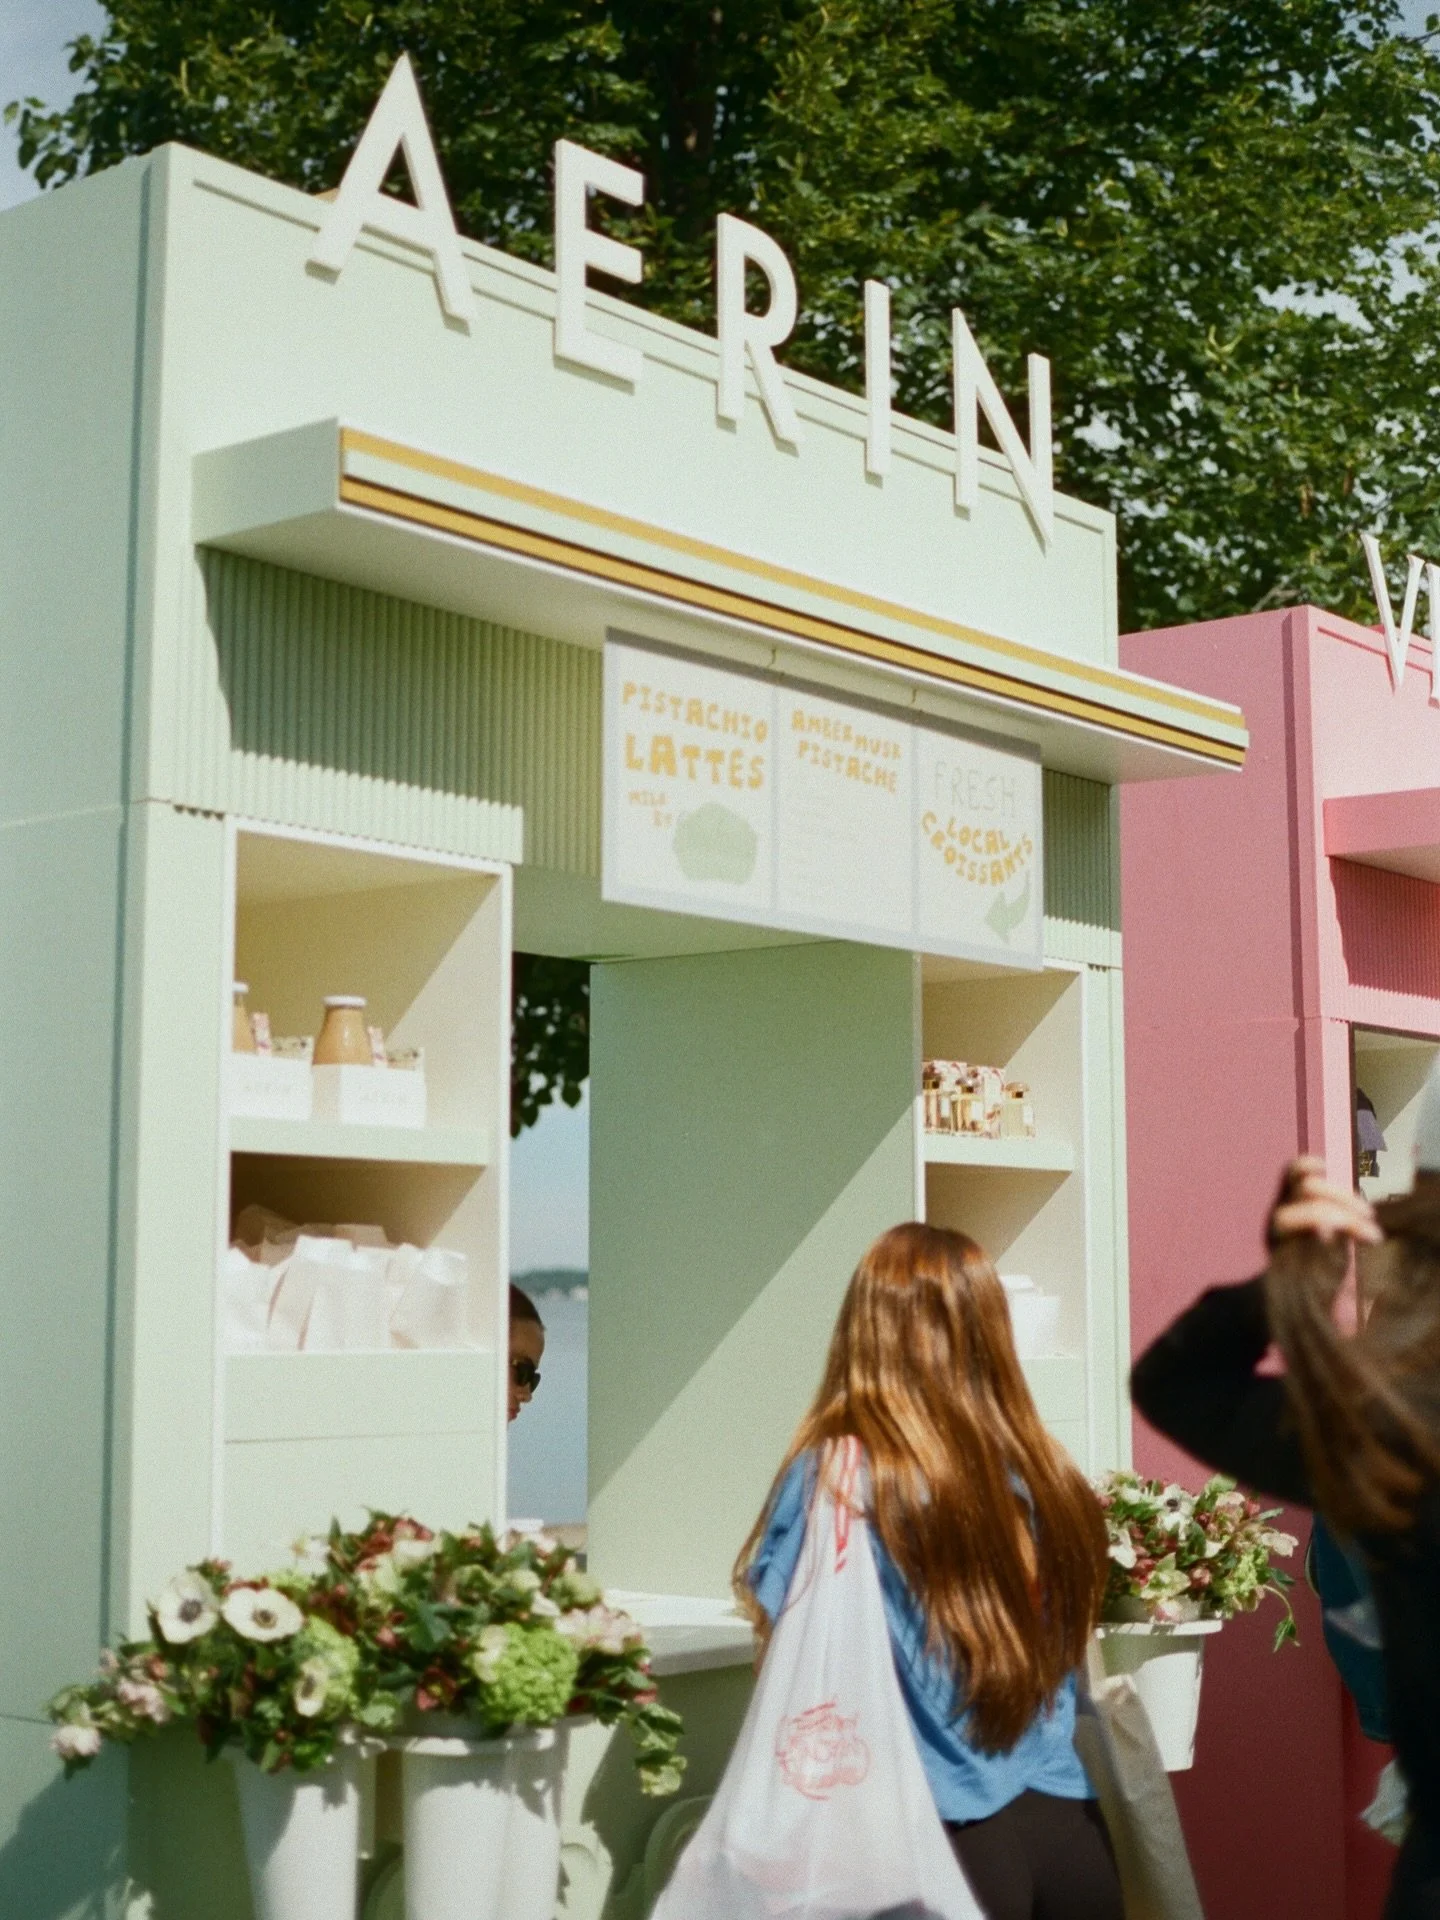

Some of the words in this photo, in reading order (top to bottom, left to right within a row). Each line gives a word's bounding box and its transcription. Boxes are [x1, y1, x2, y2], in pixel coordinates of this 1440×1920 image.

[306, 52, 1054, 550] AERIN
[622, 681, 769, 744] PISTACHIO
[624, 732, 766, 790] LATTES
[797, 739, 898, 794] PISTACHE
[934, 760, 1017, 818] FRESH
[921, 809, 1034, 887] CROISSANTS
[945, 815, 1011, 855] LOCAL
